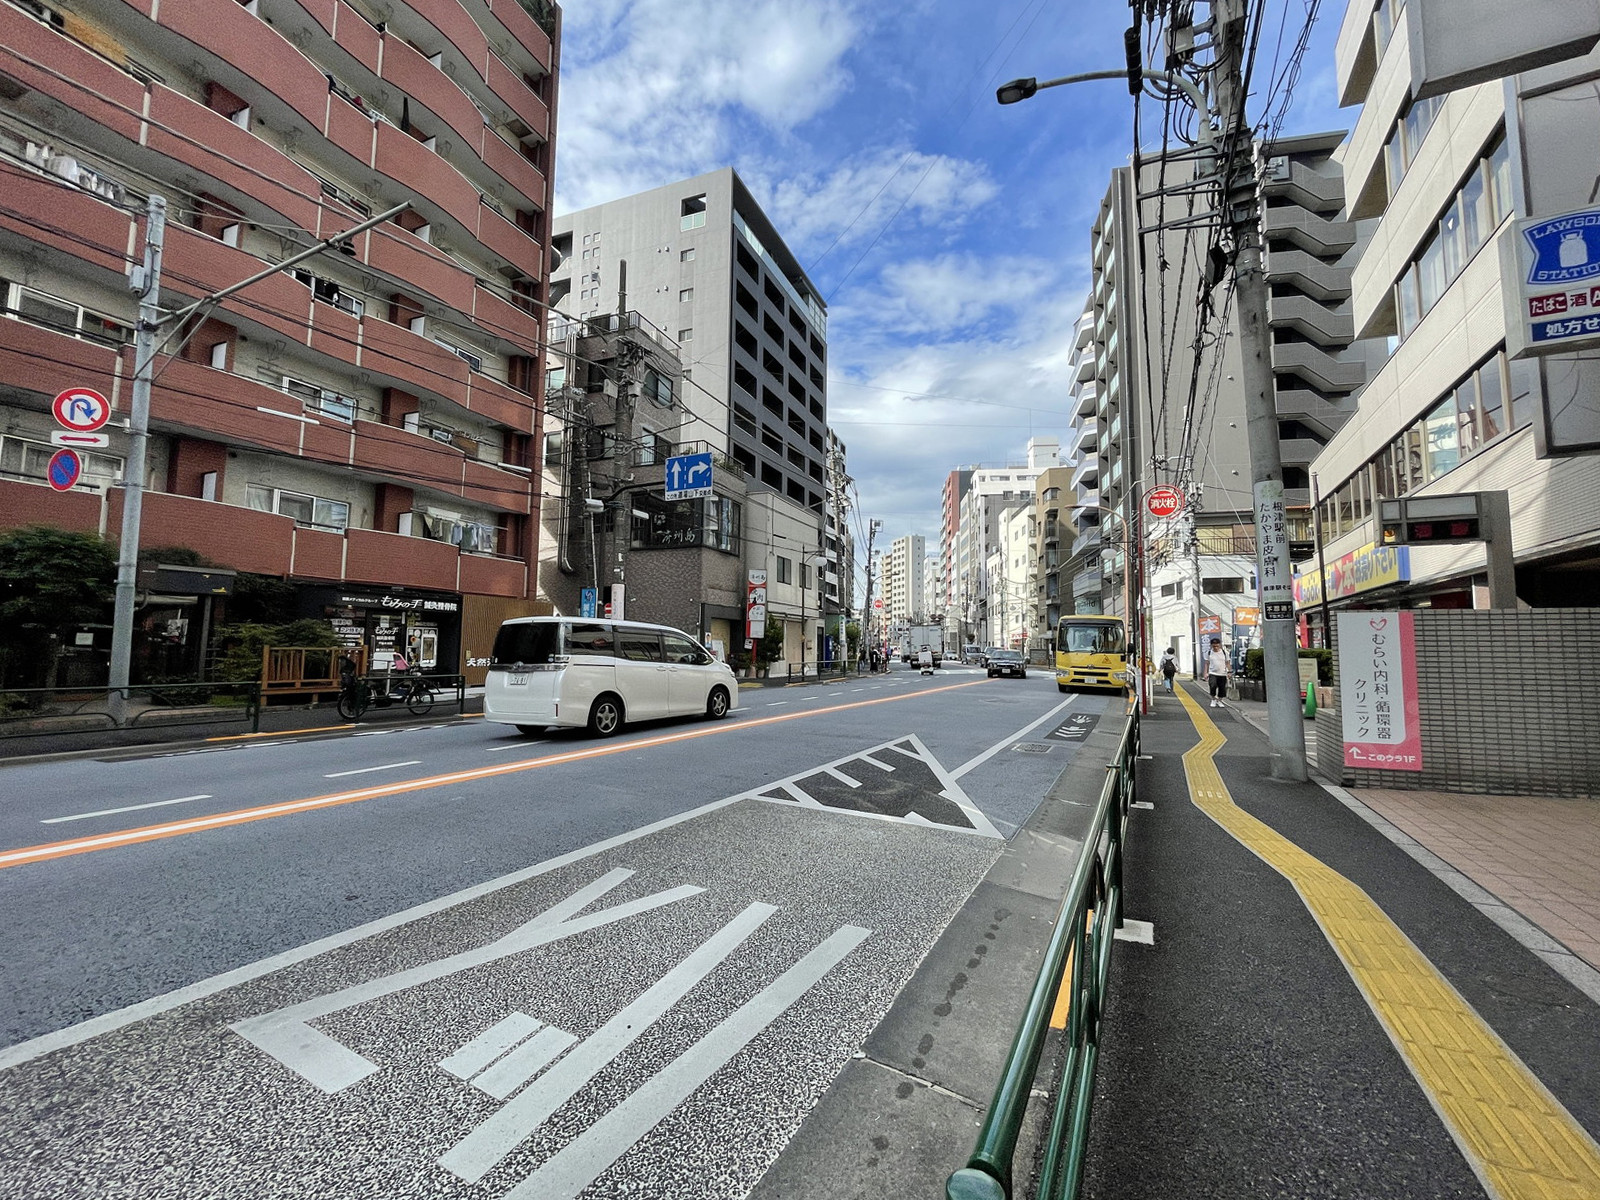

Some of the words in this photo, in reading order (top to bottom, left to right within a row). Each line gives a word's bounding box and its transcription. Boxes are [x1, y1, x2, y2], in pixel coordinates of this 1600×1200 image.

[1531, 295, 1567, 314] たばこ
[1570, 292, 1588, 308] 酒
[1546, 316, 1600, 338] 処方せ
[1150, 497, 1176, 510] 消火栓
[1272, 501, 1286, 544] 根津駅前
[1259, 502, 1276, 577] たかやま皮膚科
[380, 595, 423, 609] もみの手
[1200, 618, 1219, 632] 本
[1371, 632, 1392, 740] むらい内科・循環器
[1353, 677, 1370, 738] クリニック
[1367, 752, 1416, 764] このウラ1F
